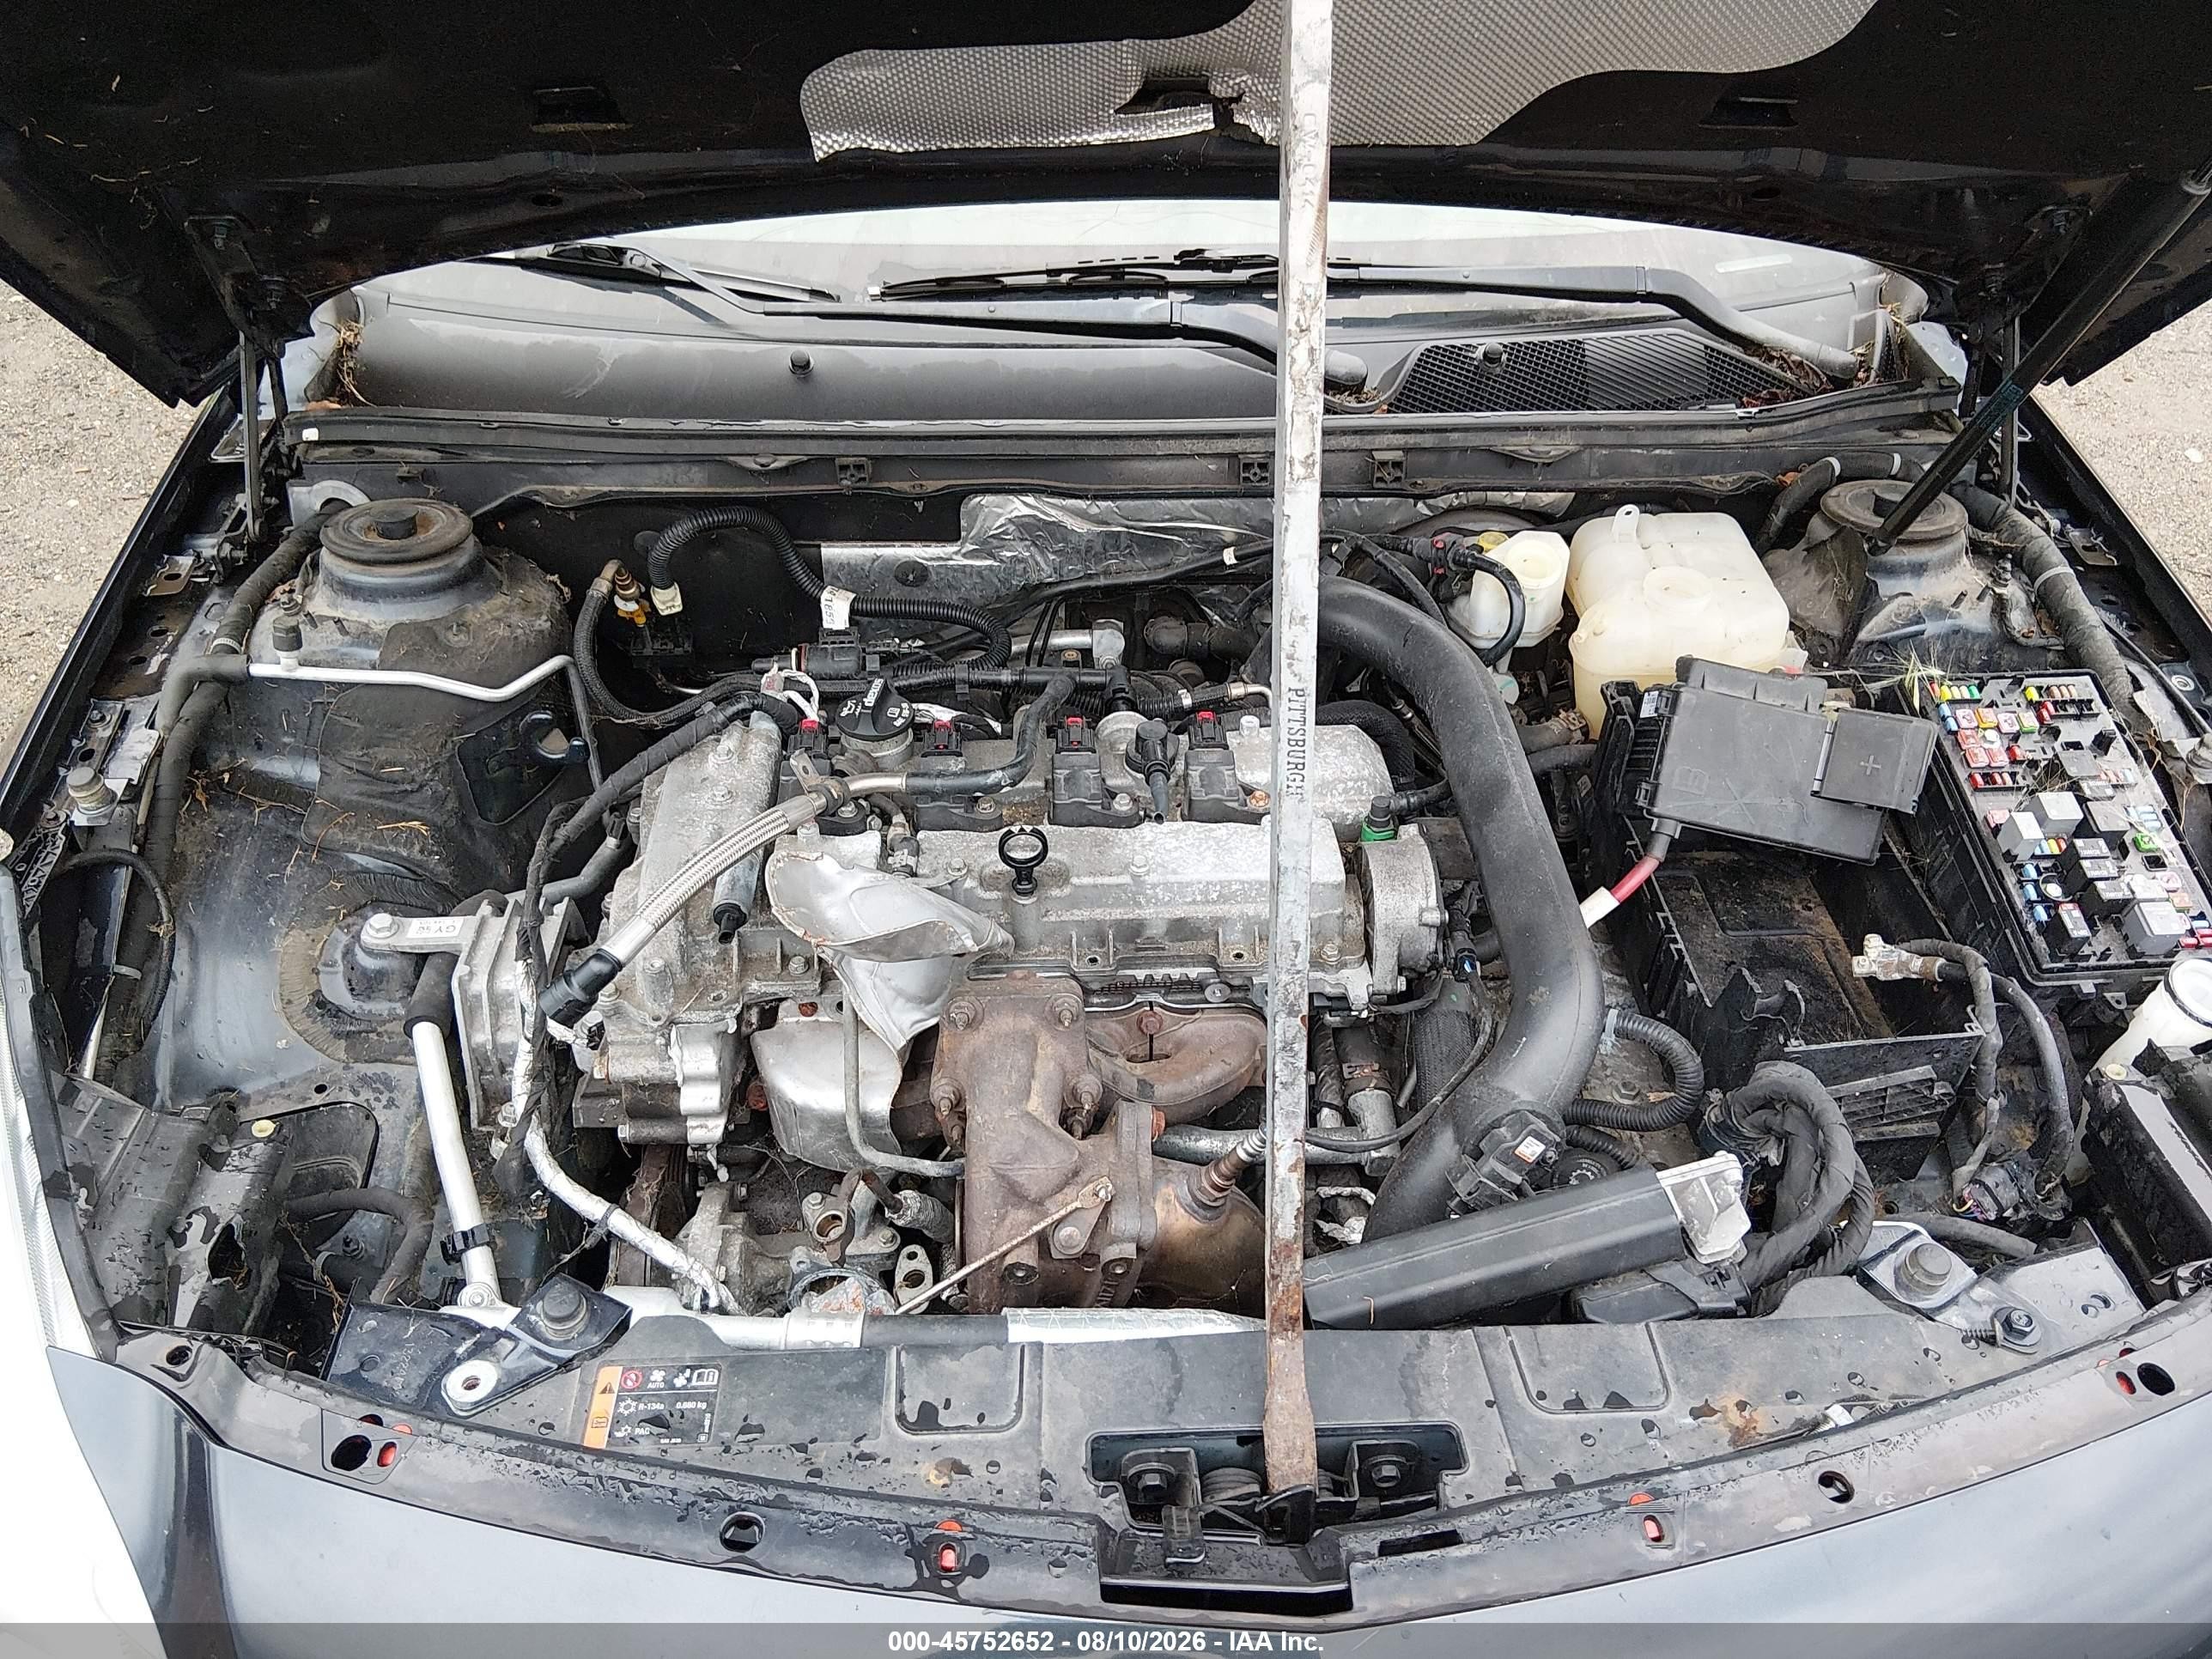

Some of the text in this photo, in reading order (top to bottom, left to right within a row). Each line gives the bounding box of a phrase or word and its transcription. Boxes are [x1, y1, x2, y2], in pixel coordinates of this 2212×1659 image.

[863, 678, 884, 706] dexos
[1286, 687, 1306, 802] PITTSBURGH
[697, 1401, 708, 1409] kg
